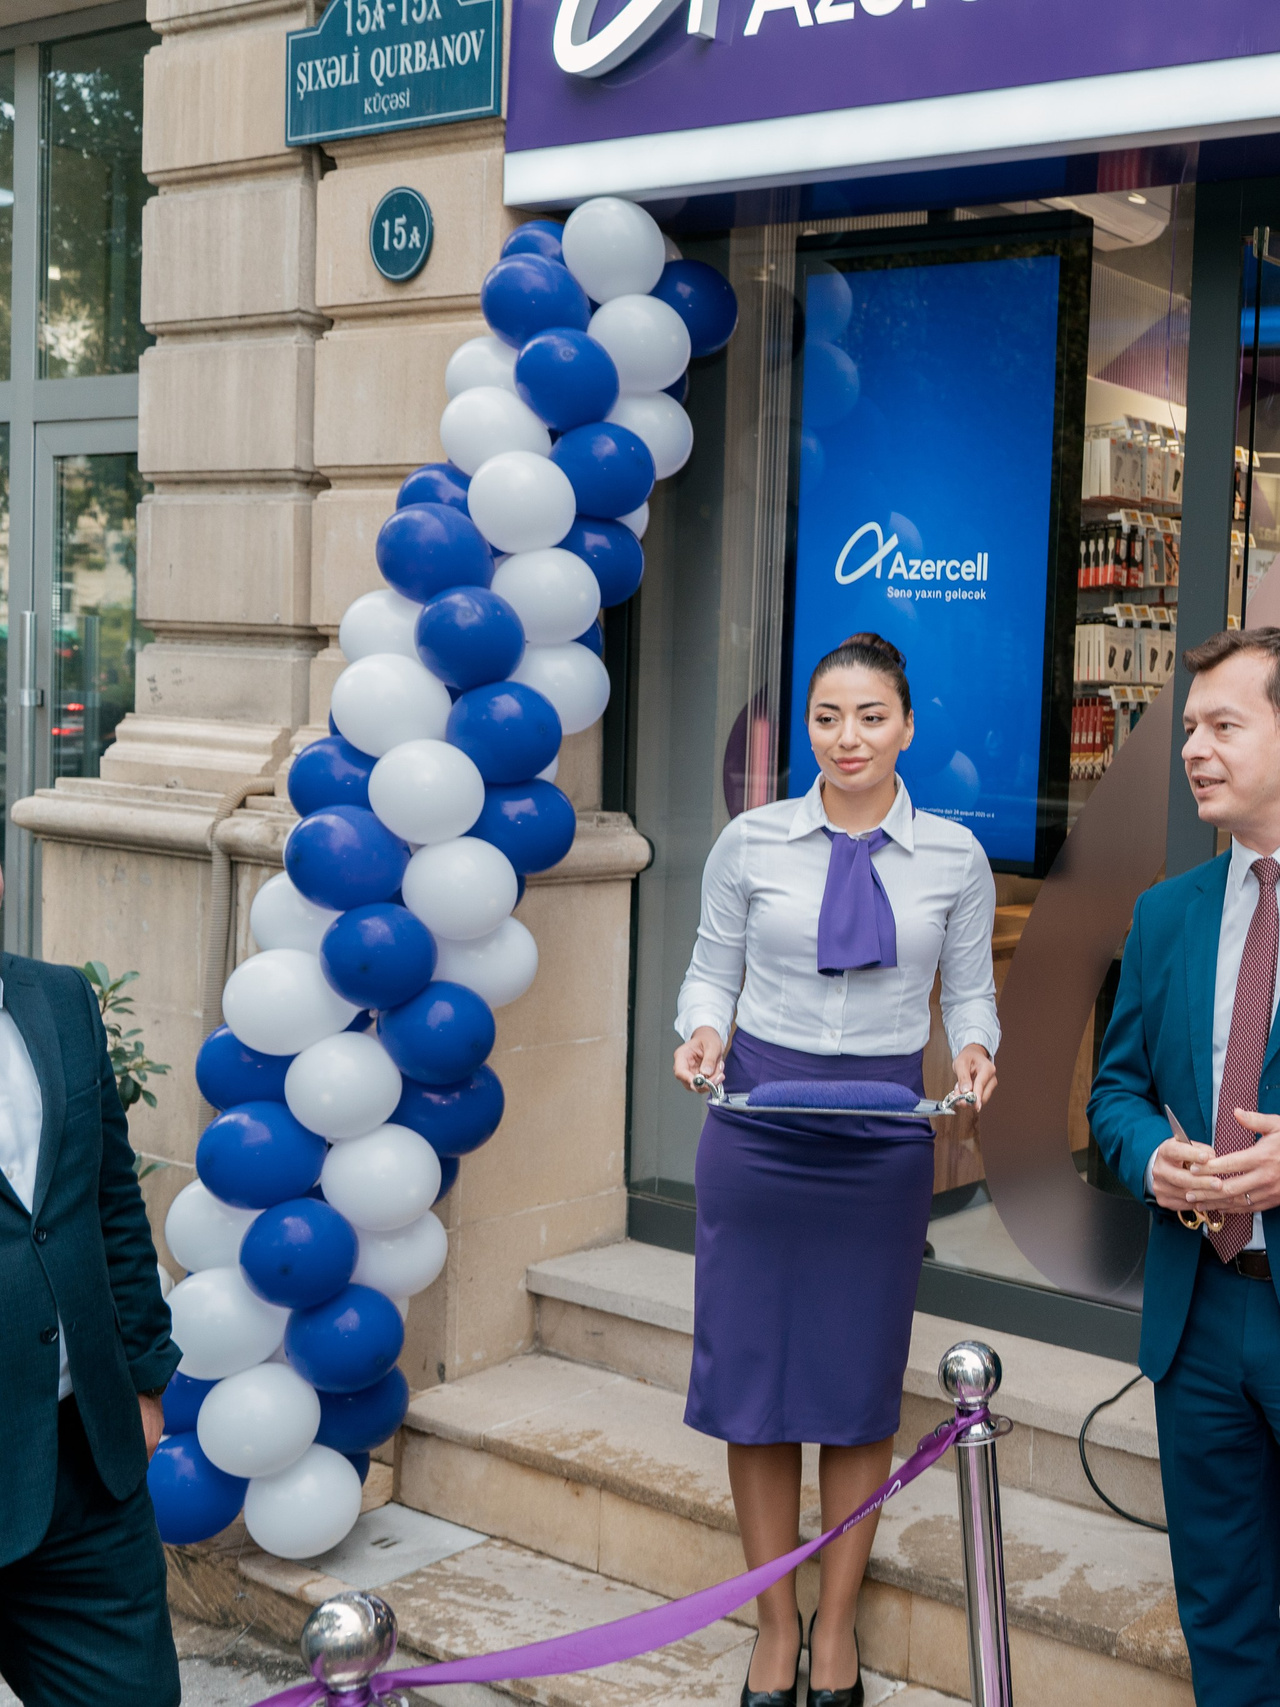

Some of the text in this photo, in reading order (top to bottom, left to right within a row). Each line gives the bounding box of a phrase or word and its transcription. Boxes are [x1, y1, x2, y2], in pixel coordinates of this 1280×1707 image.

[296, 29, 485, 100] ŞIXƏLİ QURBANOV
[363, 88, 411, 115] KÜÇƏSİ
[381, 214, 421, 251] 15A
[887, 551, 989, 582] Azercell
[915, 588, 942, 602] yaxın
[944, 587, 987, 603] gələcək
